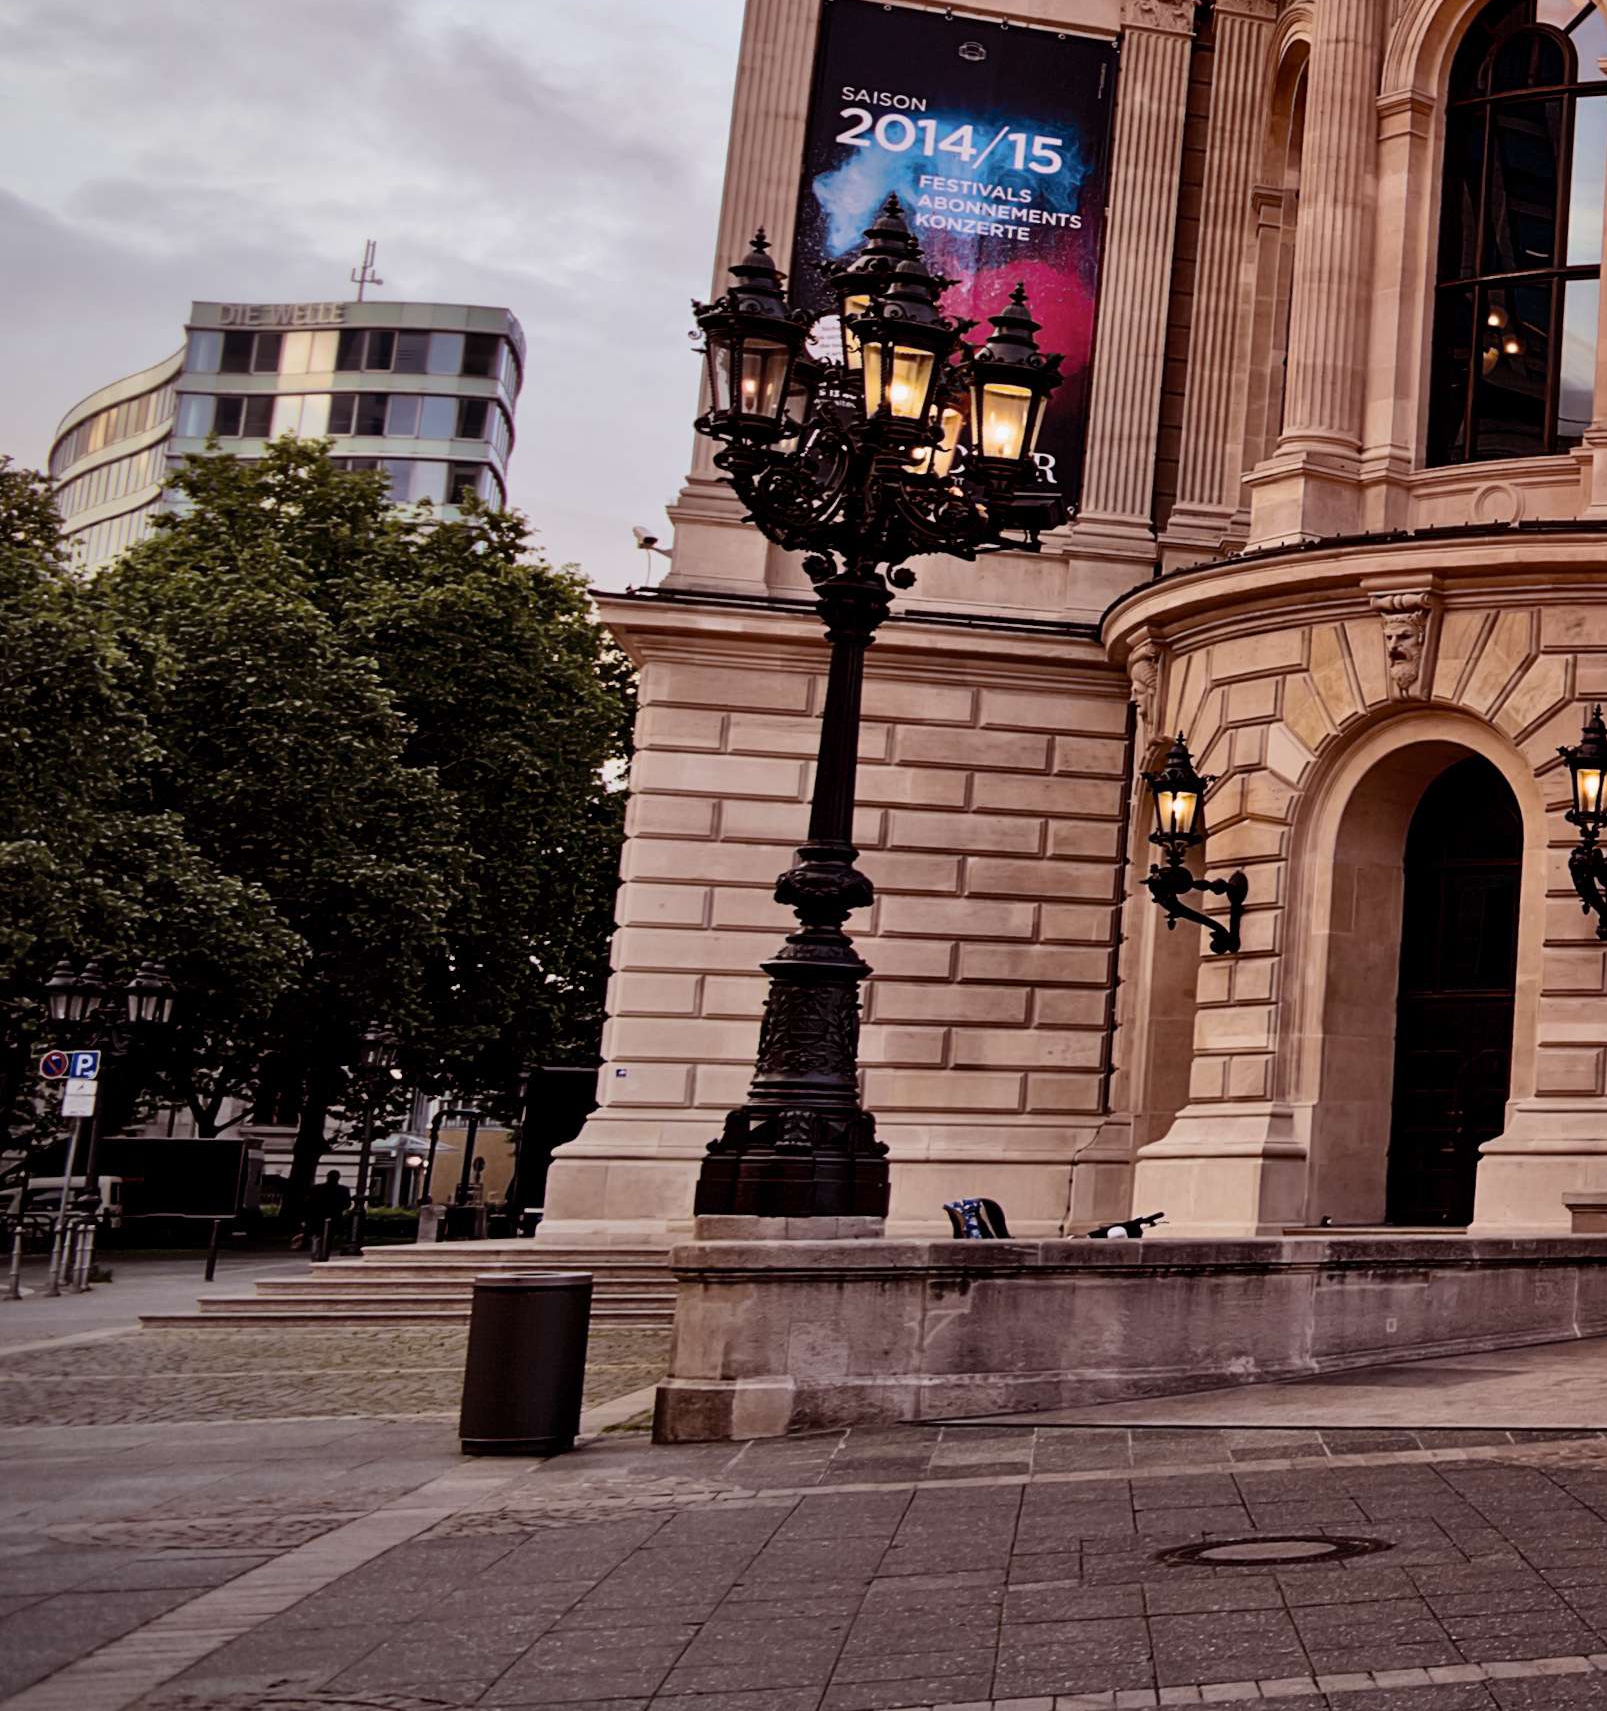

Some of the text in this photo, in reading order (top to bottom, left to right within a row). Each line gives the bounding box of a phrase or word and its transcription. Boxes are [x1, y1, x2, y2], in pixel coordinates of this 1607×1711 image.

[841, 86, 927, 112] SAISON
[835, 107, 1063, 174] 2014/15
[919, 175, 1032, 203] FESTIVALS
[917, 194, 1082, 229] ABONNEMENTS
[915, 213, 1031, 242] KONZERTE
[220, 302, 345, 326] DIE WELLE
[76, 1054, 94, 1076] P
